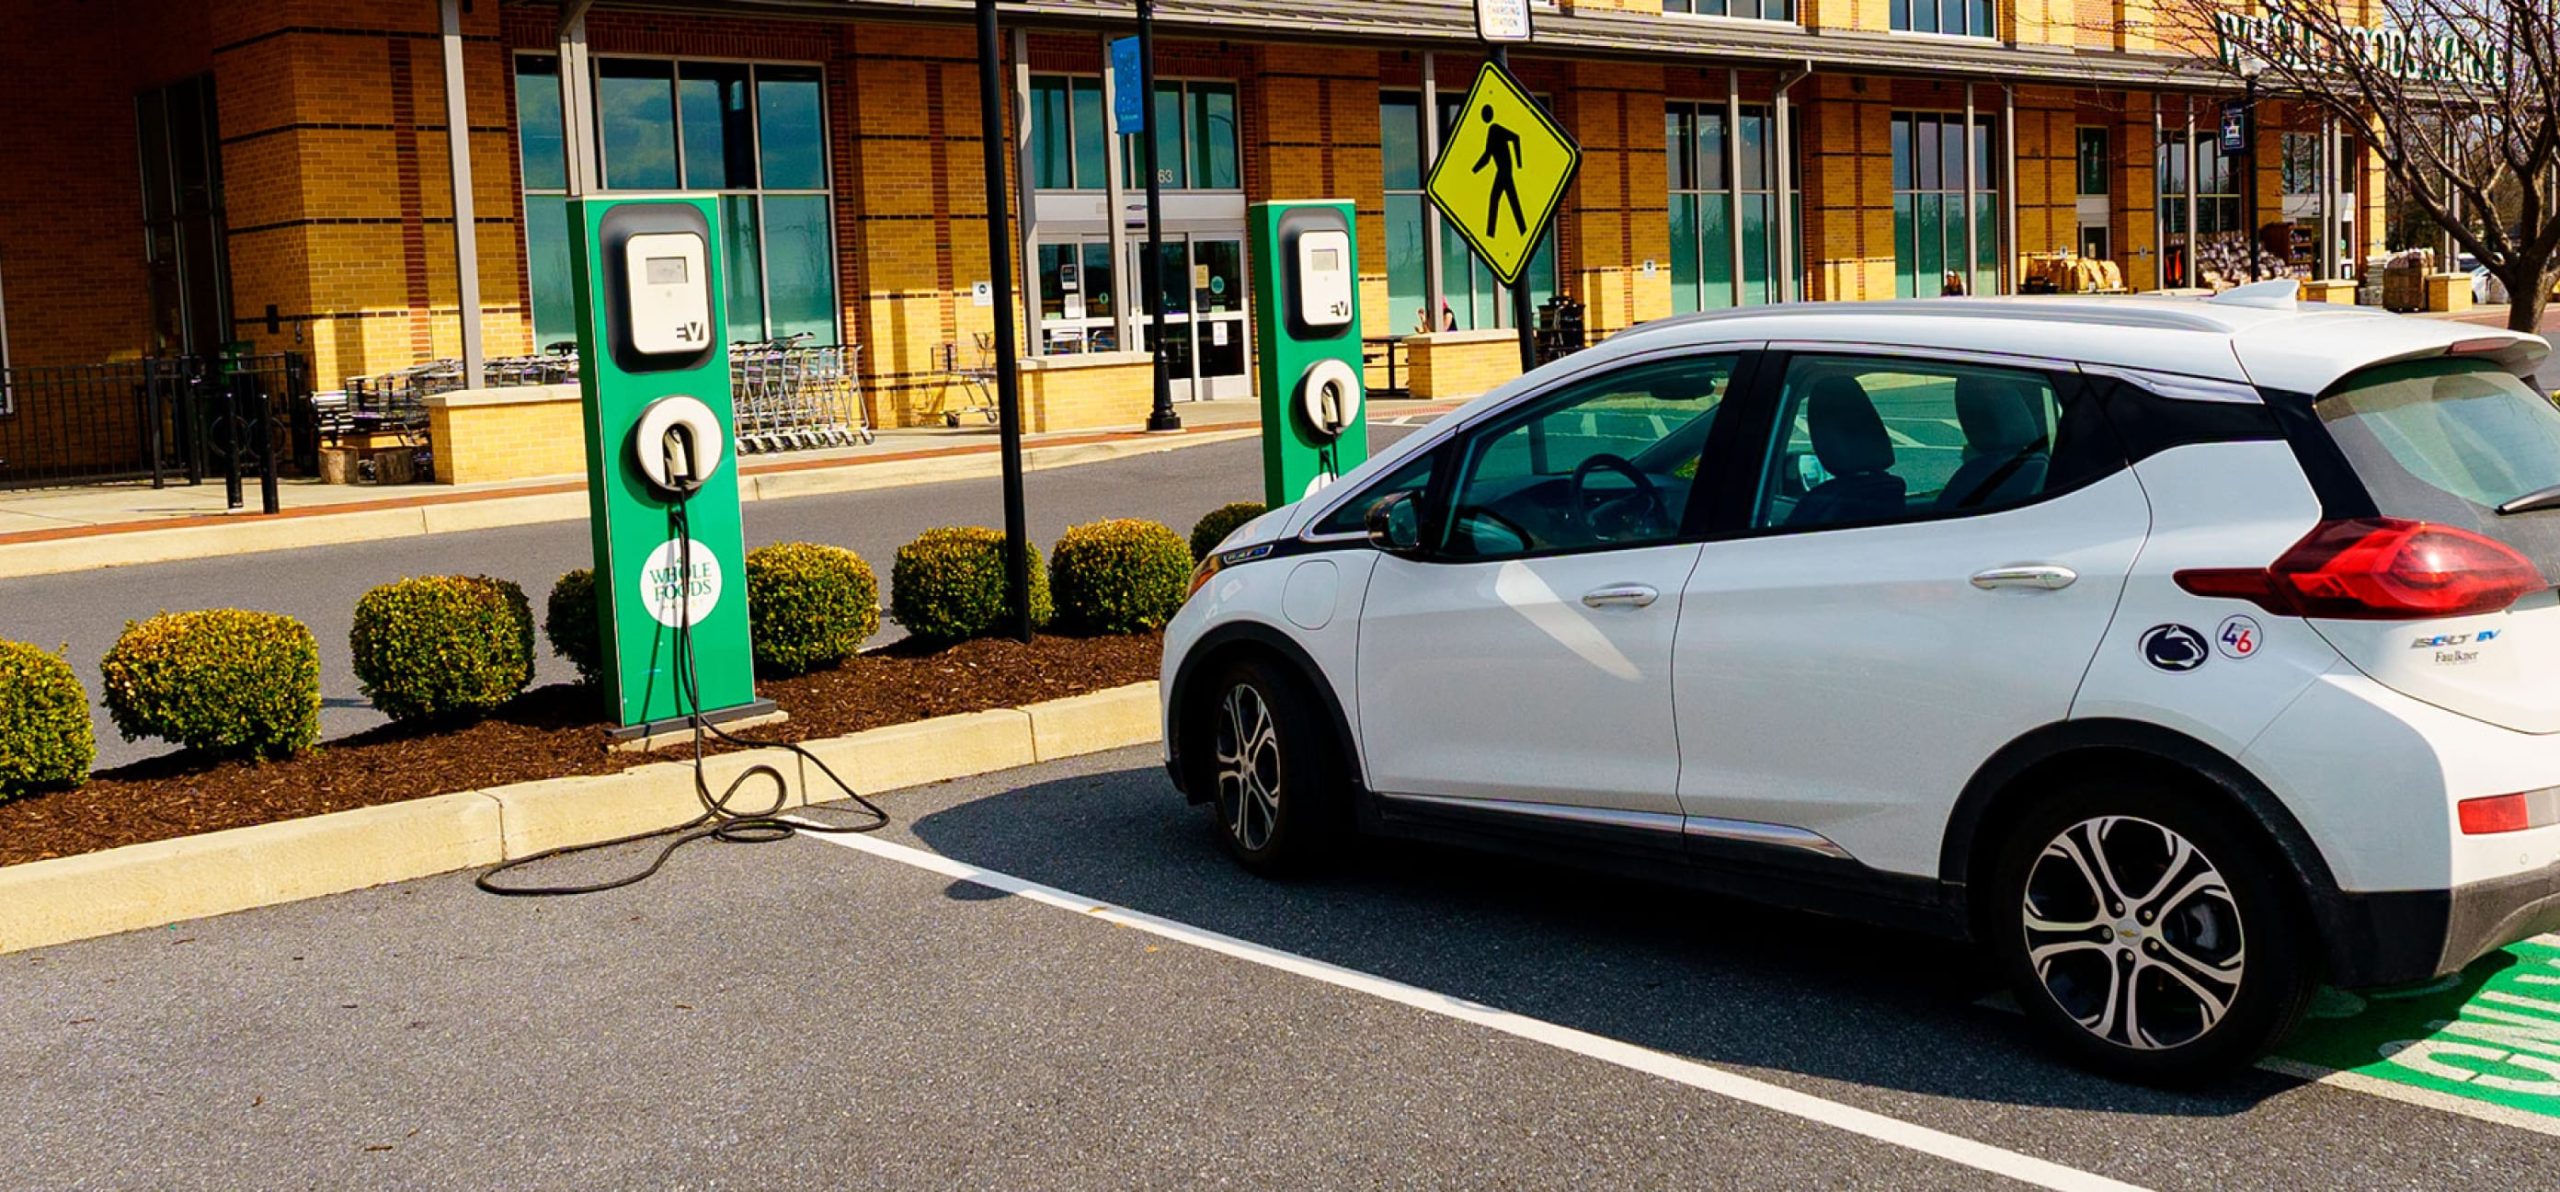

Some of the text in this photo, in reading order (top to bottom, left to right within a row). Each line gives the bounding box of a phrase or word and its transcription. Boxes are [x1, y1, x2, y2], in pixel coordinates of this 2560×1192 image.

[676, 321, 705, 342] EV
[649, 562, 712, 584] WHLE
[2221, 622, 2252, 654] 46
